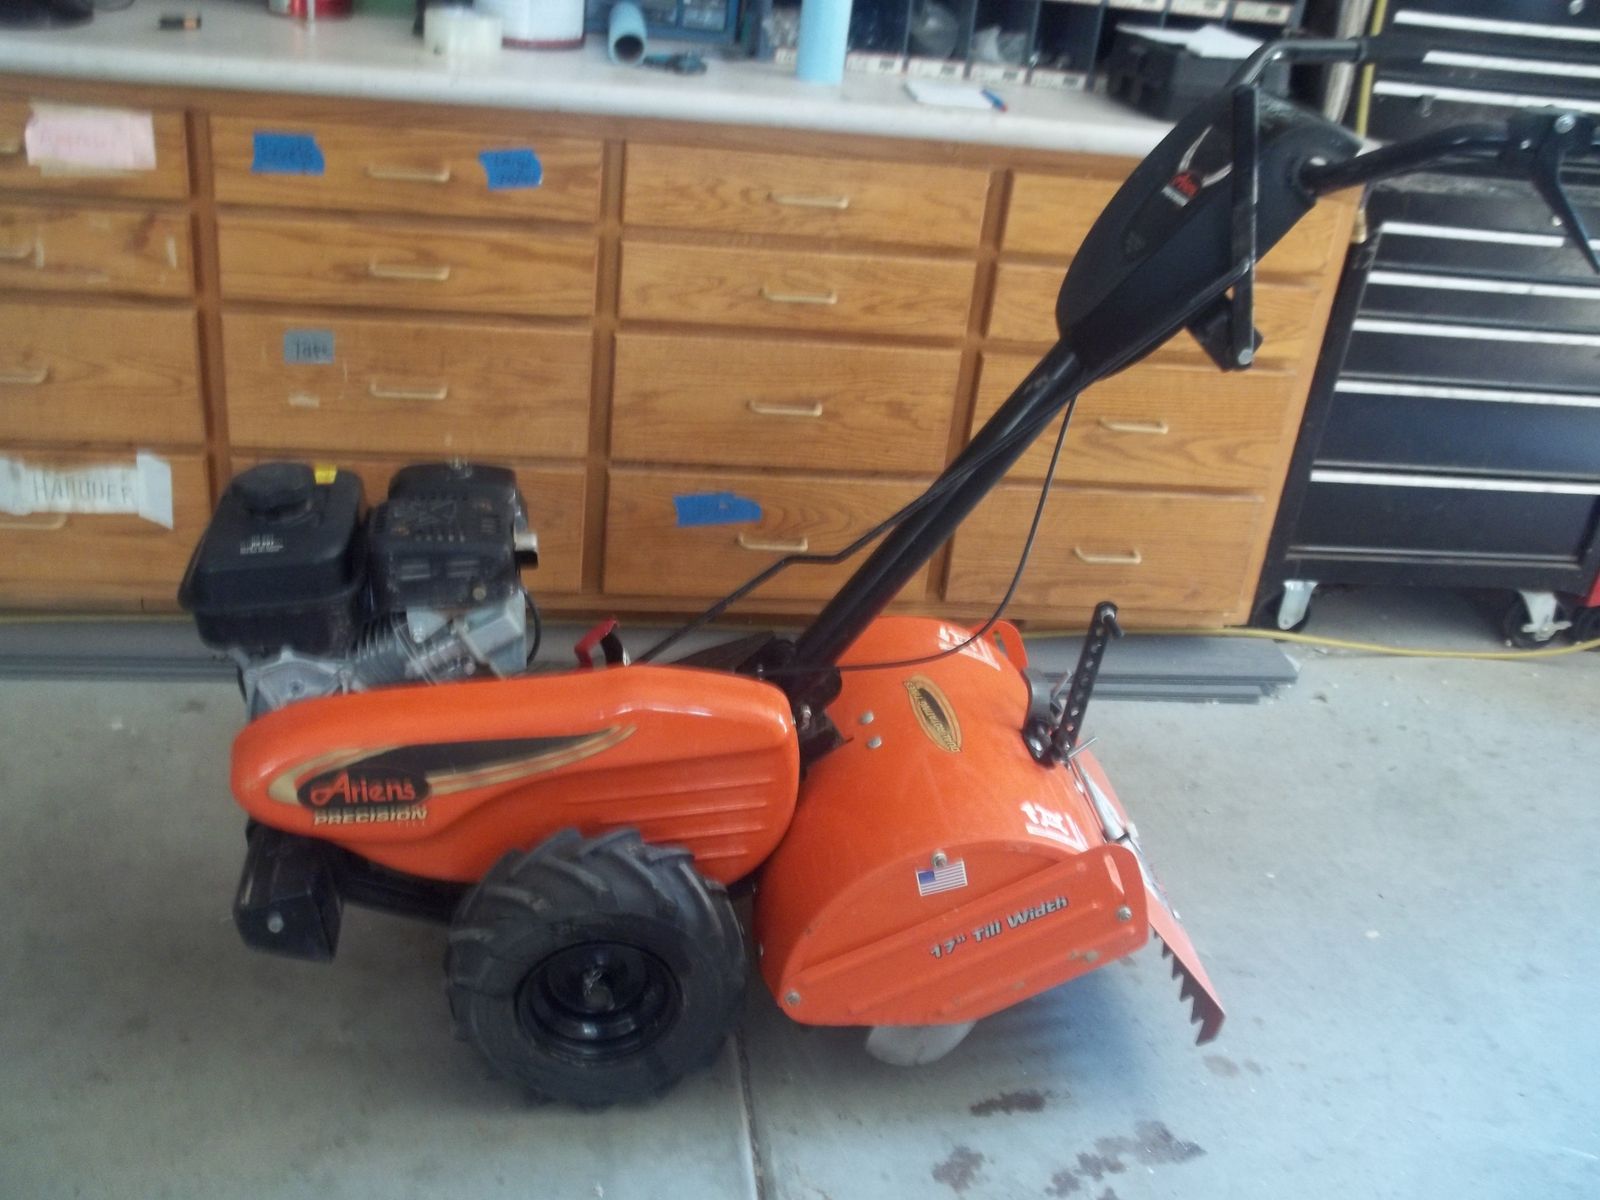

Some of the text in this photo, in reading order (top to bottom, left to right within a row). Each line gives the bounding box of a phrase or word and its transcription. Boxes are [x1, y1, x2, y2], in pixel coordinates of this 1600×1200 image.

[310, 770, 416, 806] Ariens
[314, 807, 427, 825] PRECISION
[930, 896, 1069, 958] 17" Till Width
